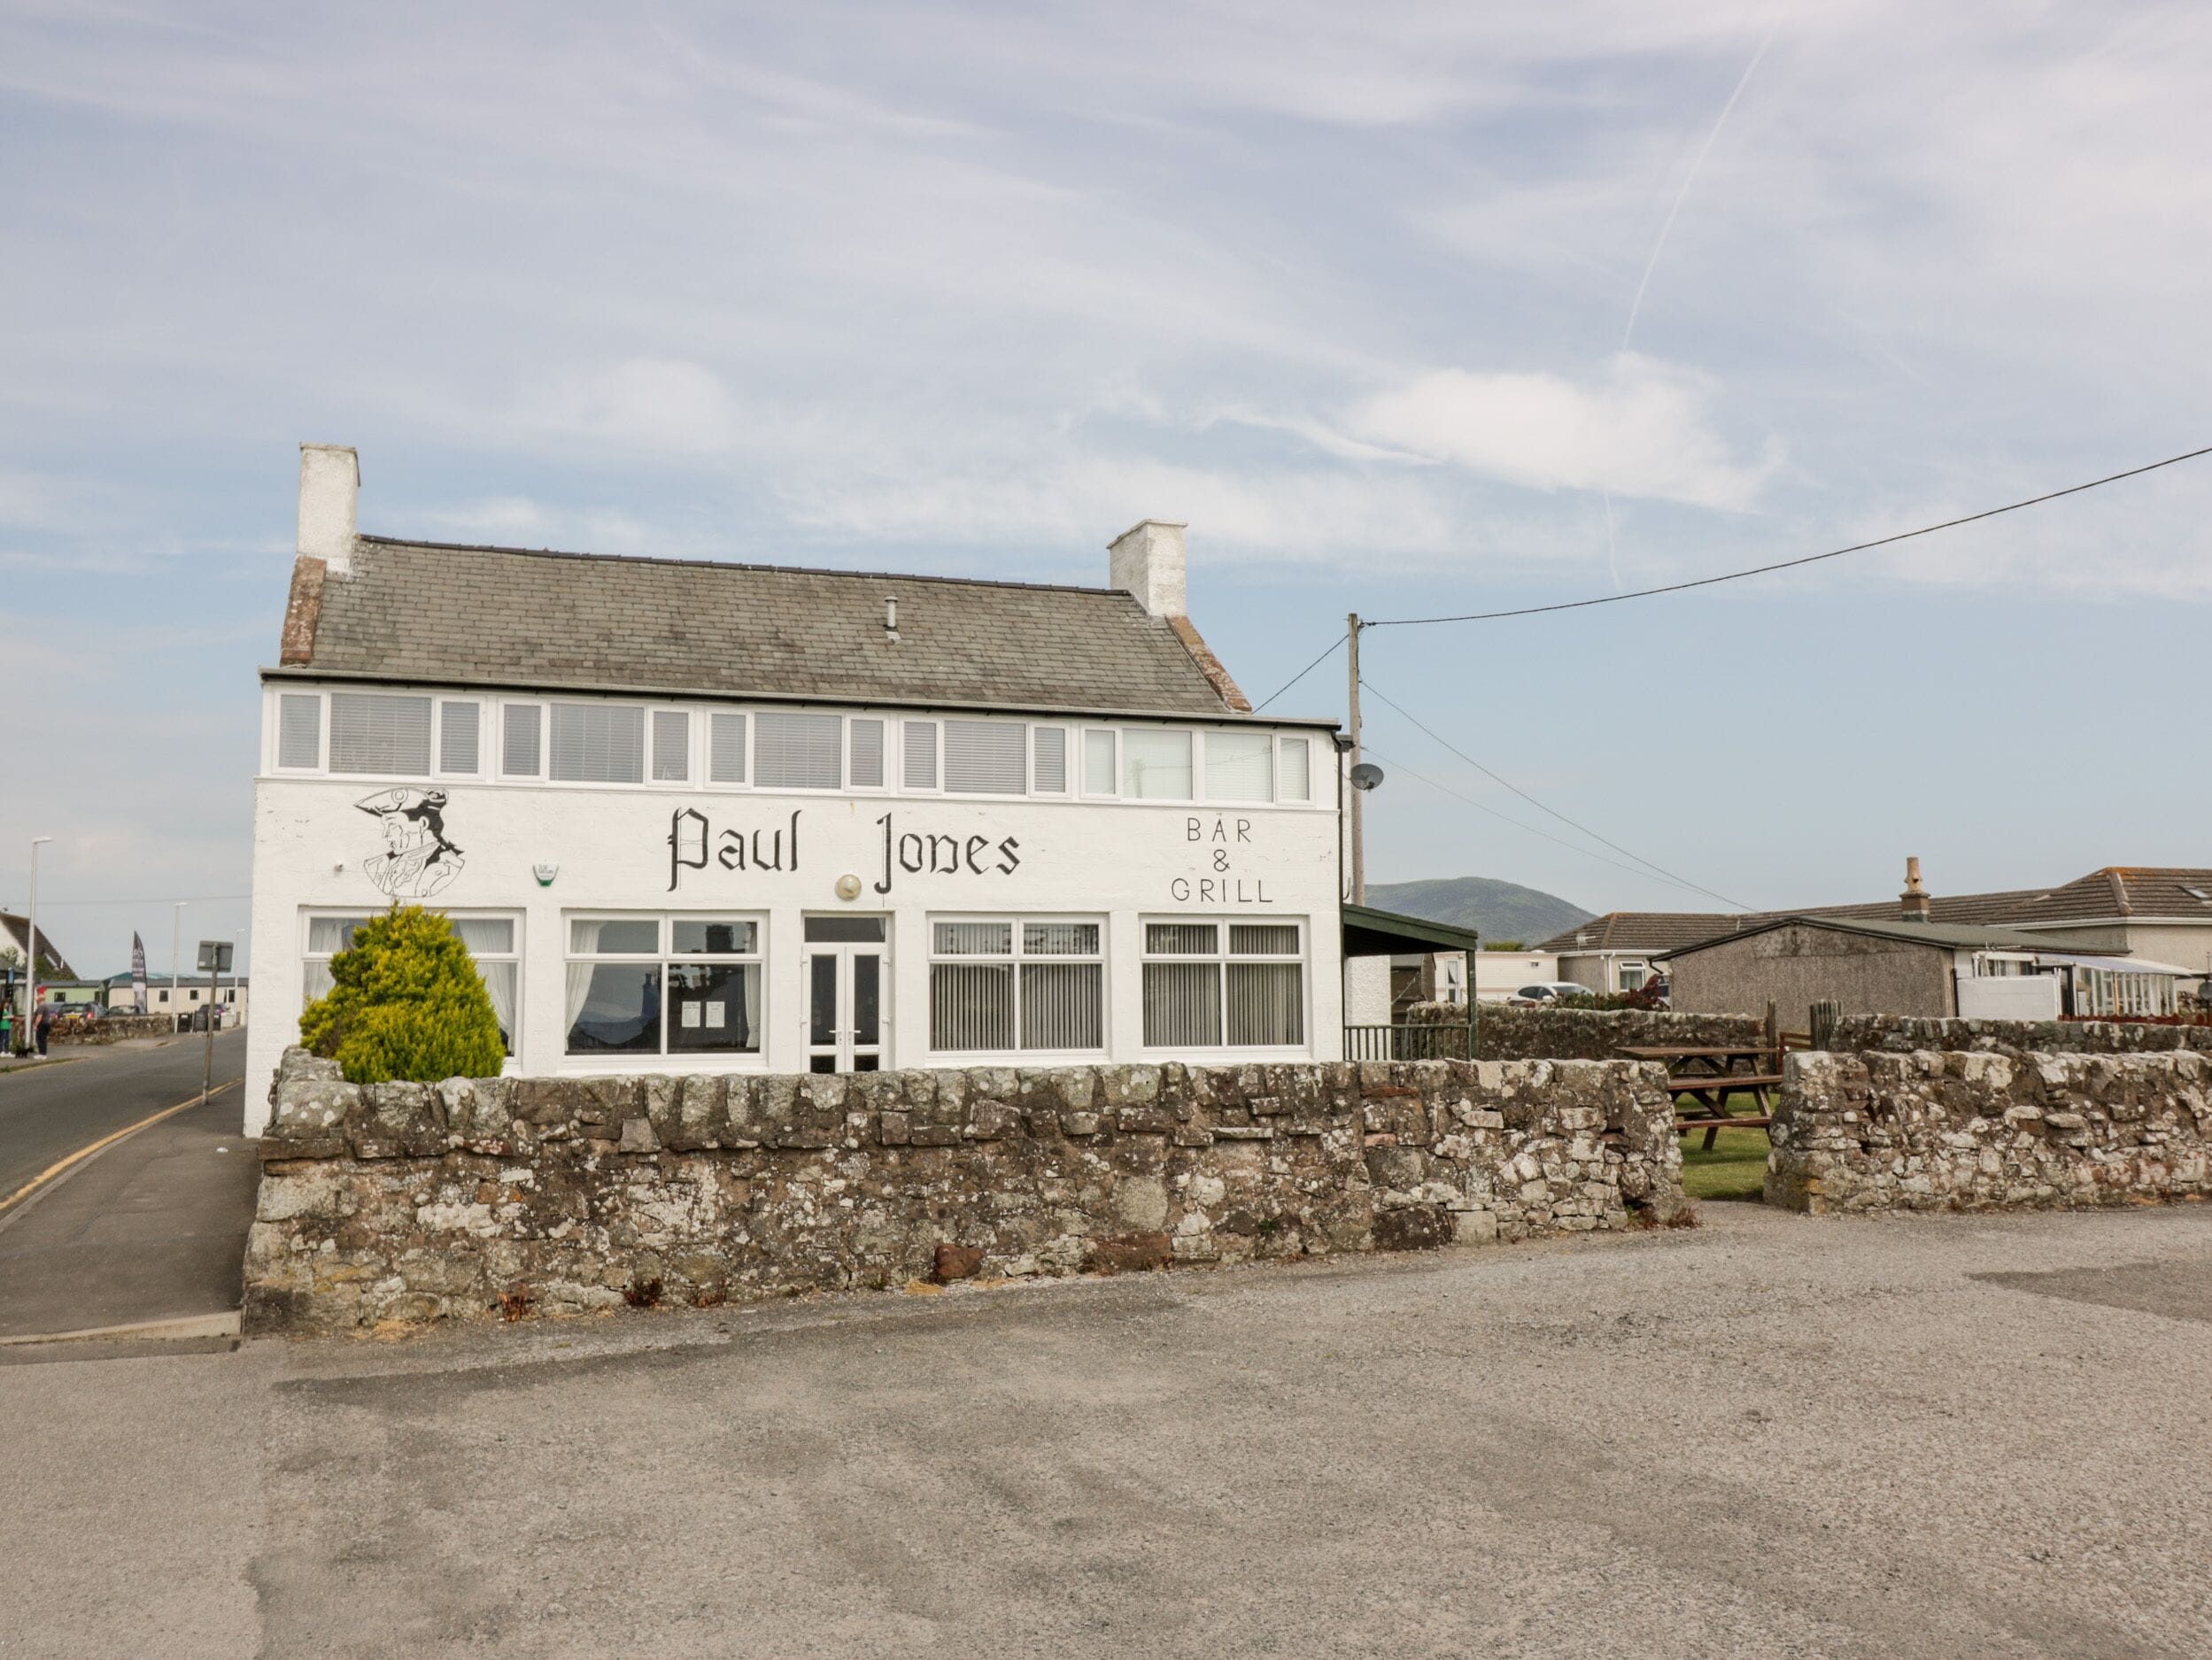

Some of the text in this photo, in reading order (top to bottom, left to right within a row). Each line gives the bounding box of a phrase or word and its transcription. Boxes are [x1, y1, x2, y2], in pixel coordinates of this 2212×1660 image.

[1187, 817, 1251, 842] BAR
[667, 807, 1021, 894] Paul Jones
[1213, 849, 1230, 872] &
[1172, 877, 1272, 903] GRILL
